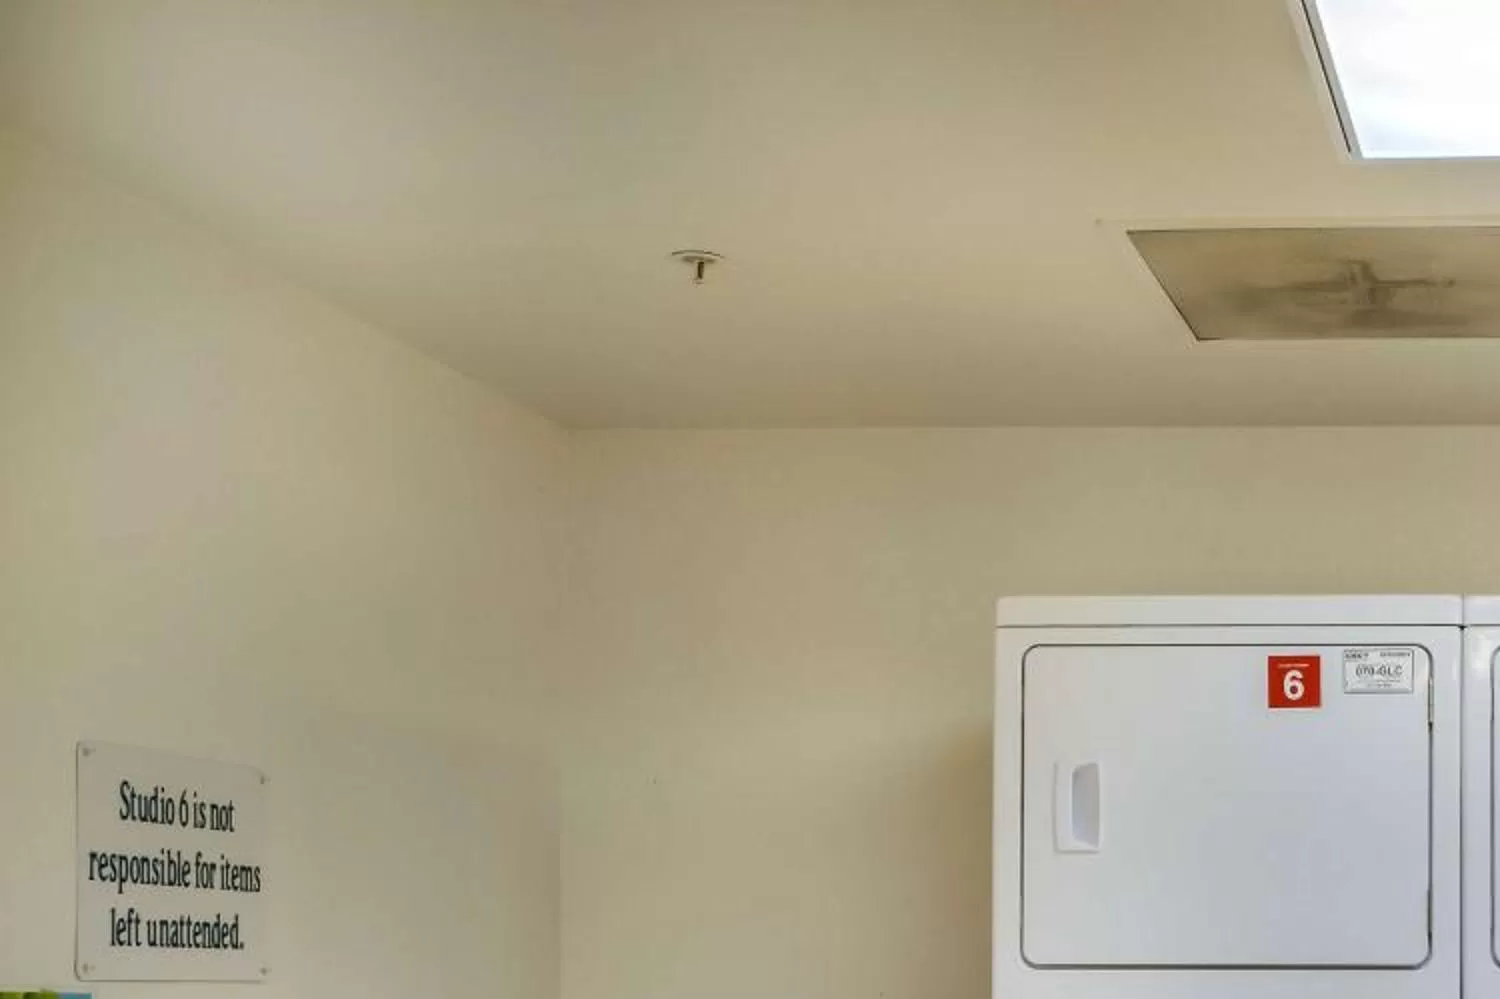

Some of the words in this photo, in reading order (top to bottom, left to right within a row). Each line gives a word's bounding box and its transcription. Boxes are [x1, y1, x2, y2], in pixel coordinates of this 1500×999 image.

[1283, 669, 1305, 700] 6
[119, 779, 175, 826] Studio
[178, 788, 189, 828] 6
[193, 793, 207, 829] is
[210, 799, 235, 832] not
[88, 848, 191, 894] responsible
[195, 851, 217, 890] for
[219, 855, 261, 892] items
[110, 907, 142, 946] left
[147, 913, 245, 949] unattended.
